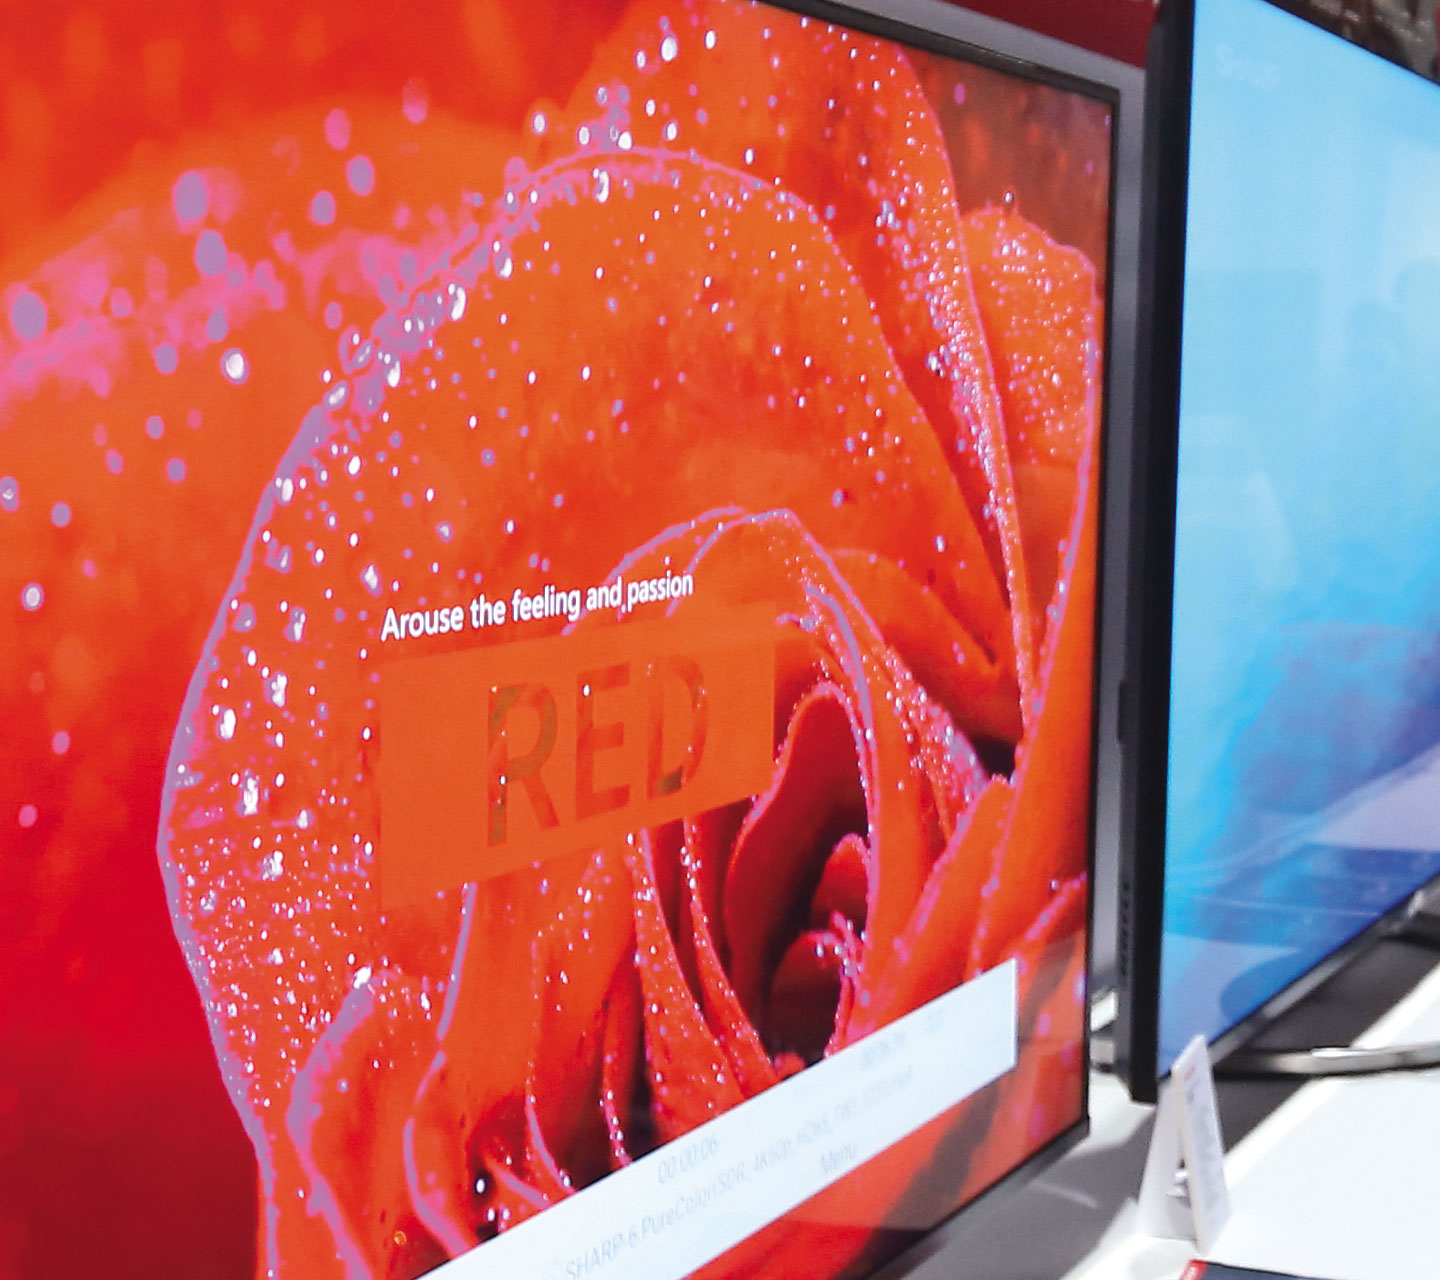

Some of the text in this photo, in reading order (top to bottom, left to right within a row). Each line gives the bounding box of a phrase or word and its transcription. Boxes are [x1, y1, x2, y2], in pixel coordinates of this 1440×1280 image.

[380, 569, 694, 641] Arouse the feeling and passion
[487, 653, 709, 848] RED
